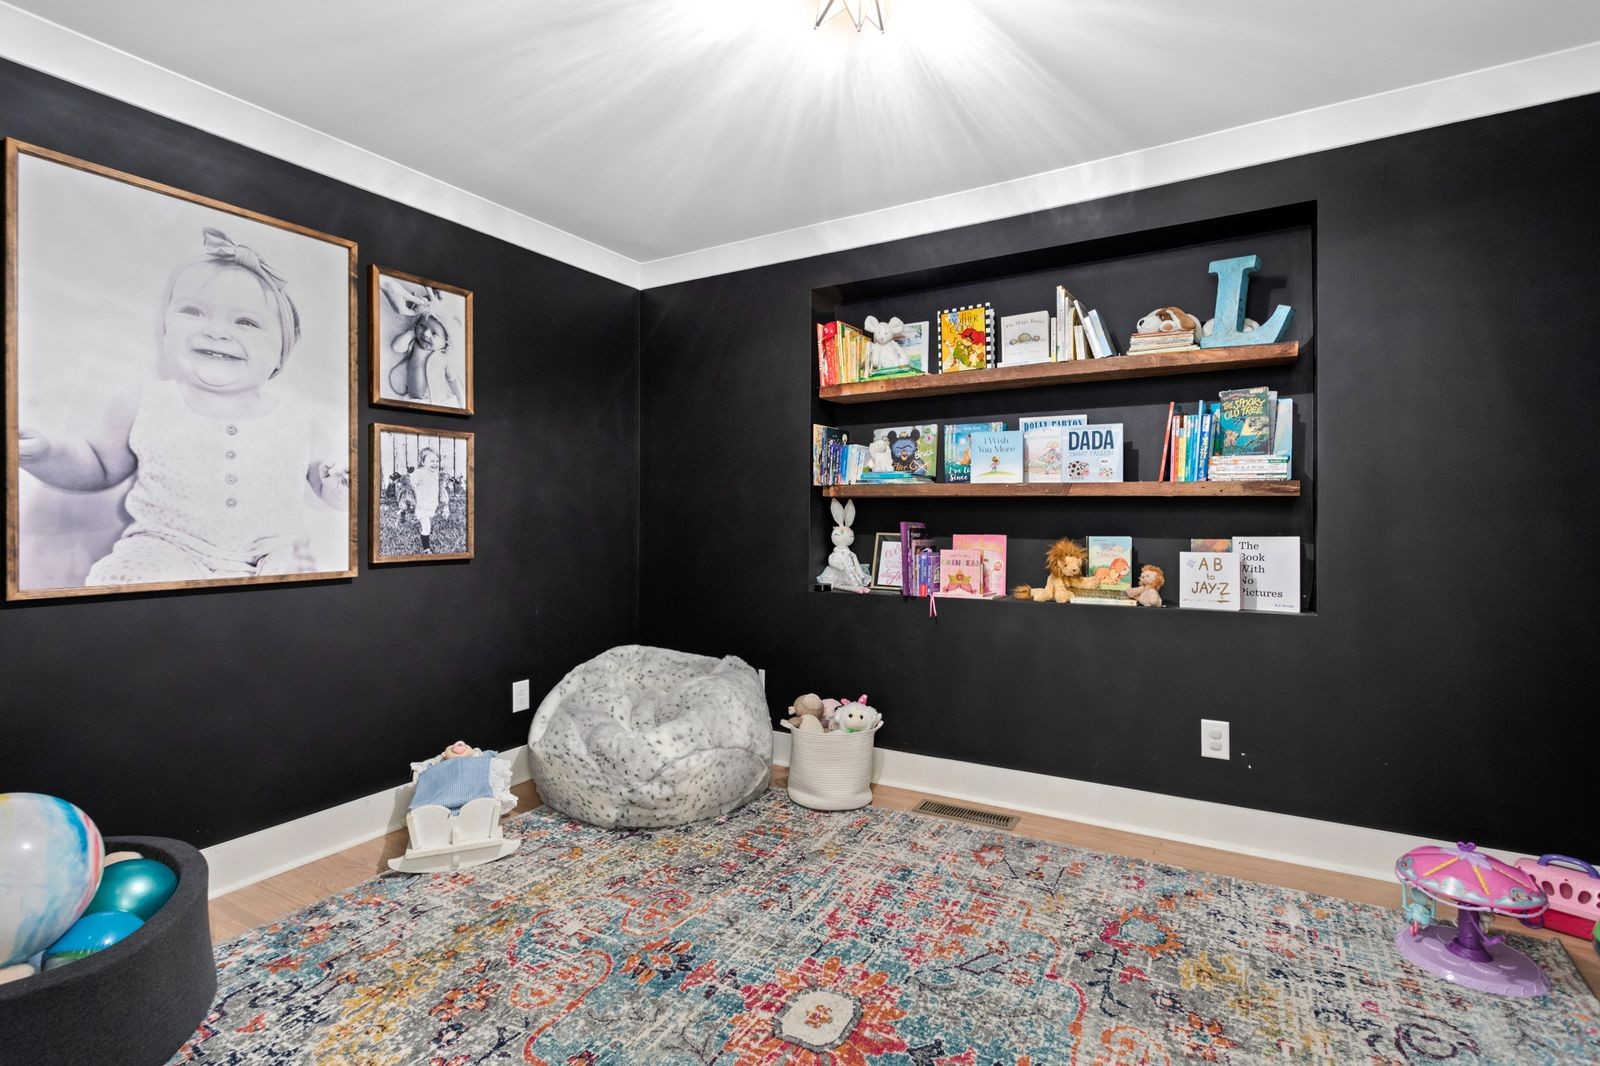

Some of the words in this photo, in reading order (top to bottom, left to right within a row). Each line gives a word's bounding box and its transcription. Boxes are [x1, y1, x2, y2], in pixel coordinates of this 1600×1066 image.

[1200, 254, 1296, 348] L
[948, 314, 979, 325] MOTHER
[1222, 401, 1233, 411] THE
[1233, 397, 1266, 410] SPOOKY
[1224, 409, 1240, 420] OLD
[1241, 405, 1263, 416] TREE
[1024, 421, 1047, 432] DOLLY
[1051, 418, 1082, 427] PARTON
[988, 436, 1009, 445] Wish
[1068, 430, 1114, 451] DADA
[994, 445, 1016, 453] More
[949, 473, 968, 482] Since
[1239, 541, 1260, 550] The
[942, 559, 979, 567] PRINESS
[1198, 557, 1209, 571] A
[1213, 557, 1223, 572] B
[1206, 573, 1215, 581] to
[1191, 581, 1230, 596] JAY-Z
